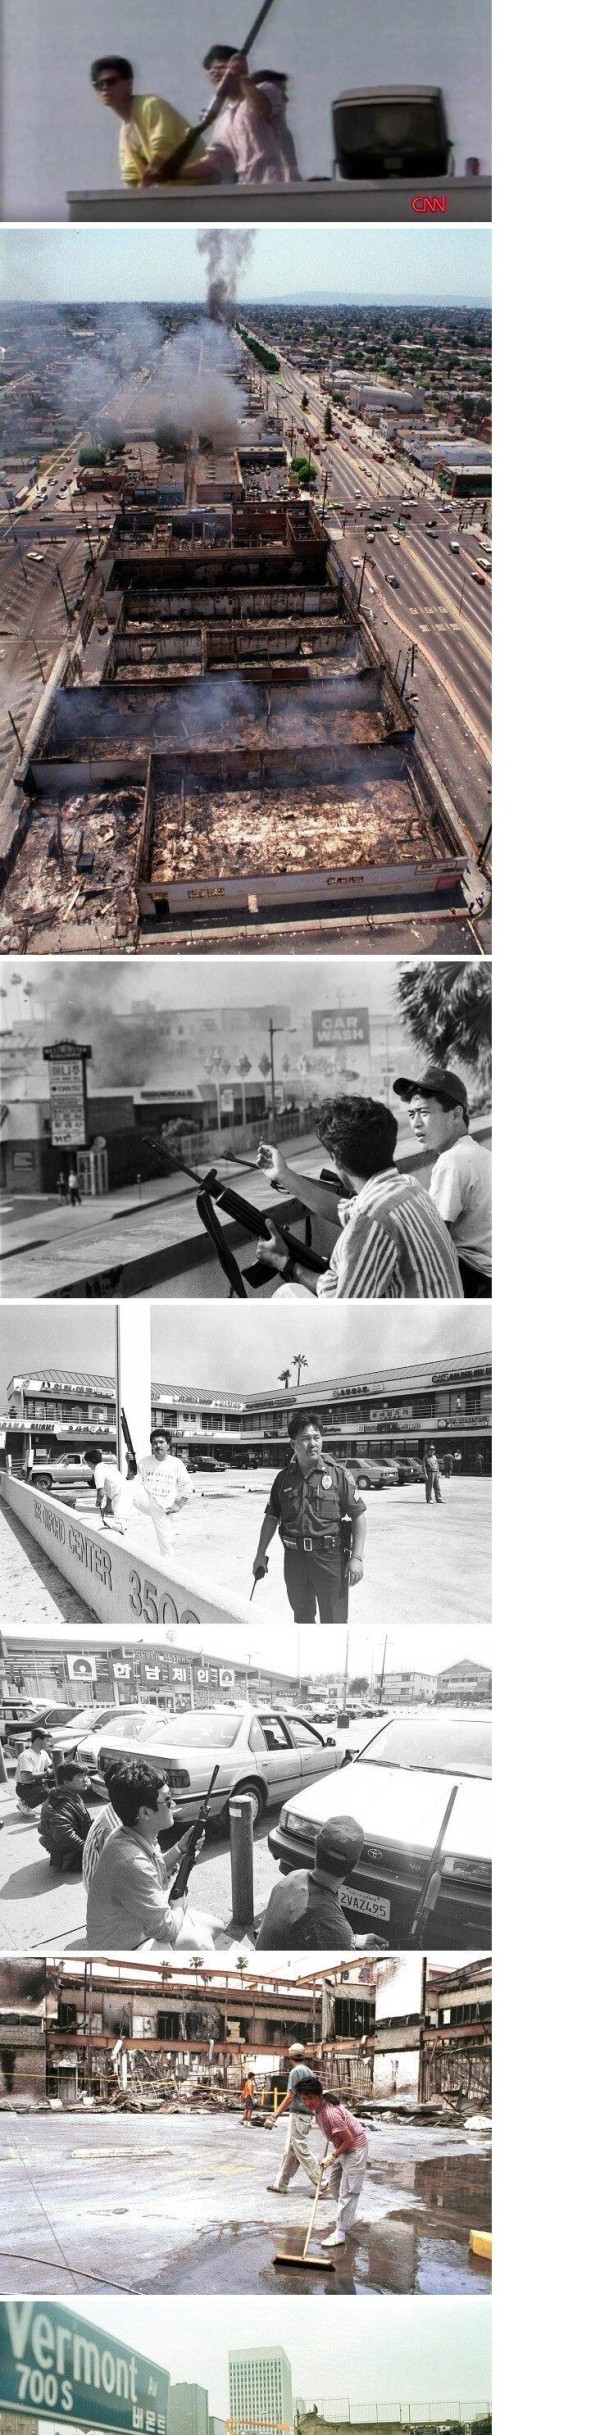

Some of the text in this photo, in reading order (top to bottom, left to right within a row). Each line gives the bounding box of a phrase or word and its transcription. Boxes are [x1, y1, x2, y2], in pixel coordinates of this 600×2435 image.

[317, 1028, 364, 1041] WASH
[322, 1016, 358, 1029] CAR
[42, 1505, 66, 1545] OXFORD
[68, 1524, 113, 1592] CENTER
[340, 1892, 386, 1917] 2VAZ495
[5, 2301, 138, 2403] Vermont
[15, 2363, 74, 2411] 700 S
[132, 2406, 167, 2435] 버몬트
